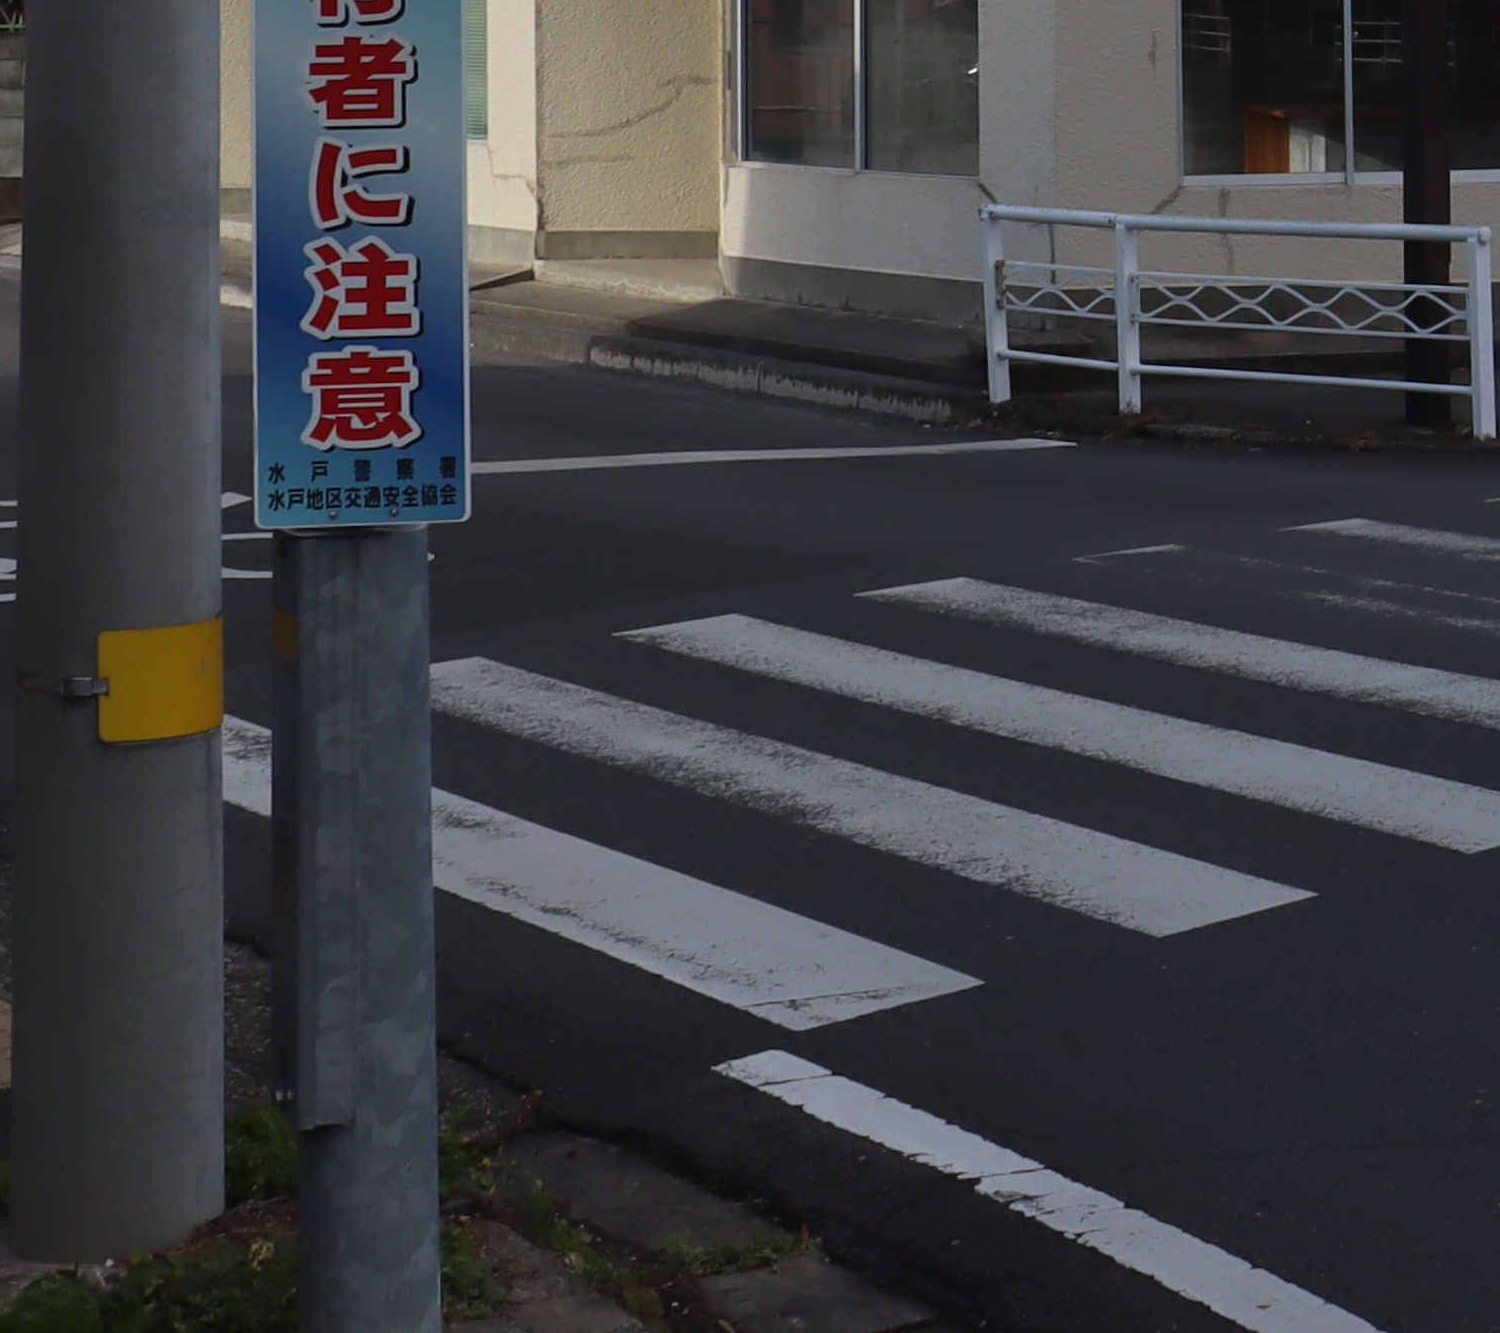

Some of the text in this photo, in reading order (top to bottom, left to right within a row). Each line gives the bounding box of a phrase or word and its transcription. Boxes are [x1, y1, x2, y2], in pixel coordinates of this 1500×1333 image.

[268, 456, 457, 484] 水戸警察署
[268, 483, 458, 512] 水戸地区交通安全協会
